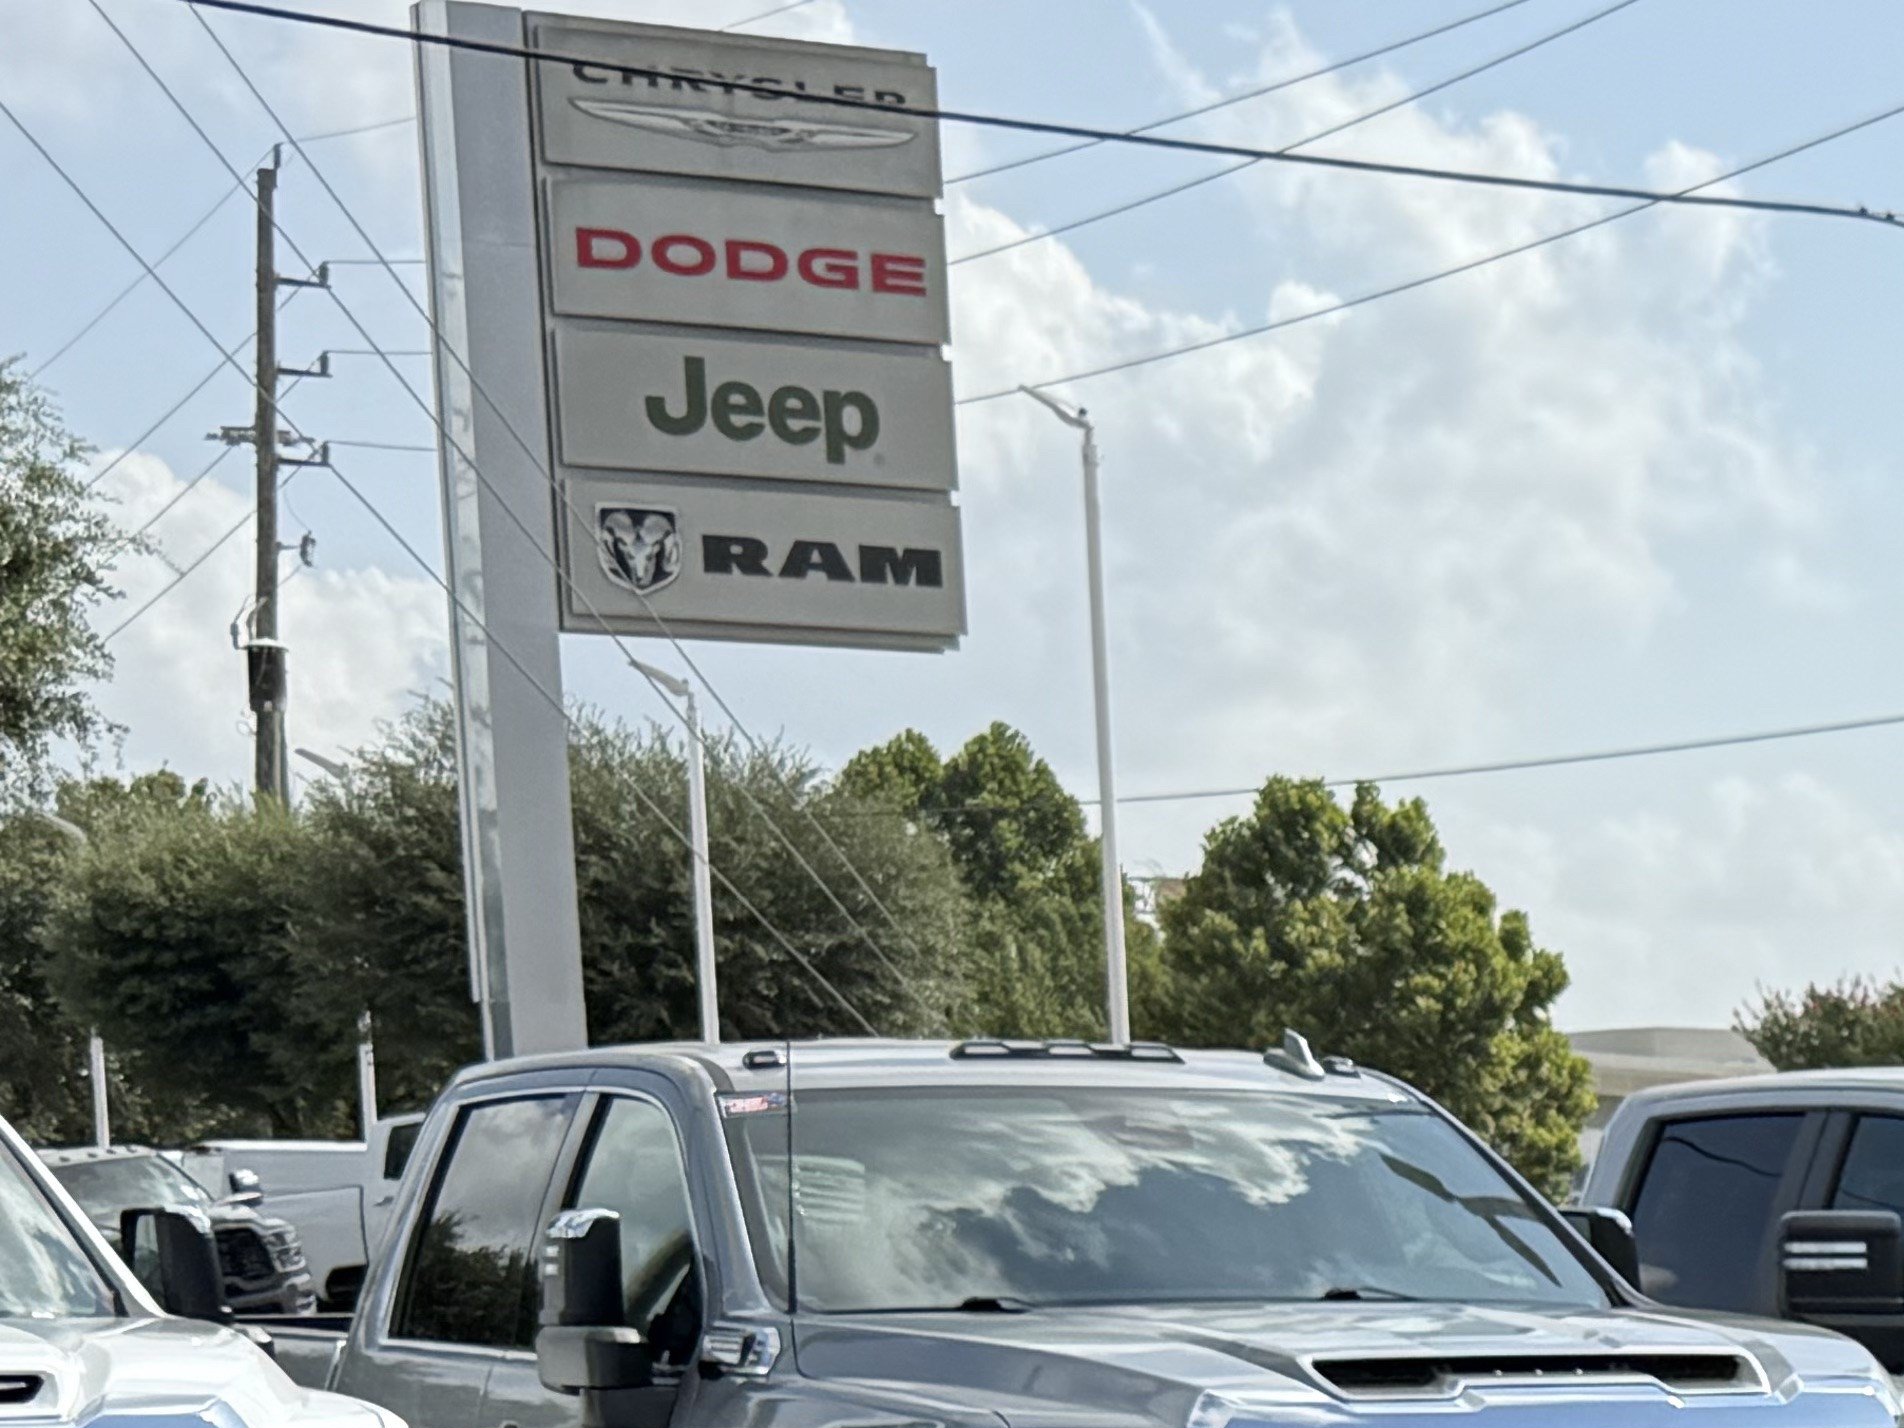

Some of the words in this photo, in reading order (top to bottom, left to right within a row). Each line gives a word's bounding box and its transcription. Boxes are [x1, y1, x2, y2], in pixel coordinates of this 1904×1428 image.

[575, 226, 927, 297] DODGE
[644, 355, 880, 465] Jeep
[702, 534, 943, 588] RAM
